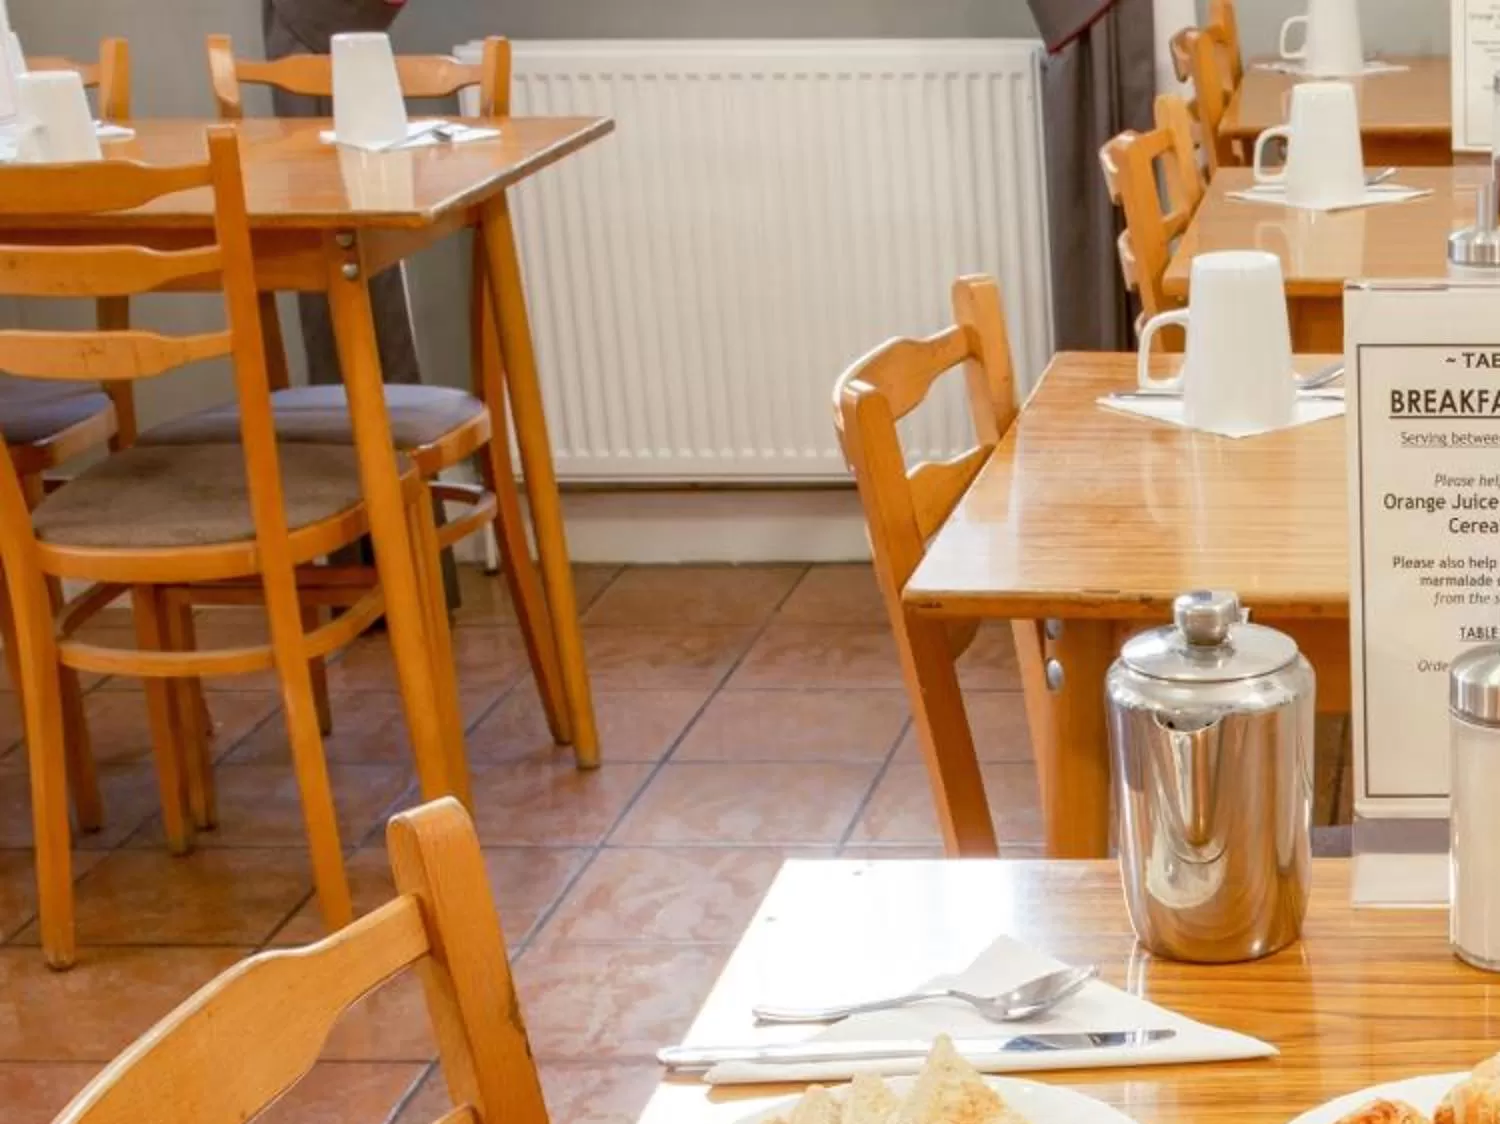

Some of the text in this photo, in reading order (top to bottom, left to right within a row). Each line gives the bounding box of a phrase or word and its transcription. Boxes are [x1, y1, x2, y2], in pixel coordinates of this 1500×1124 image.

[1401, 432, 1447, 448] Serving
[1435, 474, 1475, 487] Please
[1384, 493, 1446, 514] Orange
[1452, 493, 1499, 511] Juice
[1393, 556, 1436, 569] Please
[1439, 555, 1466, 569] also
[1469, 556, 1497, 572] help
[1433, 592, 1465, 608] from
[1469, 592, 1491, 605] the
[1460, 627, 1499, 640] TABLE
